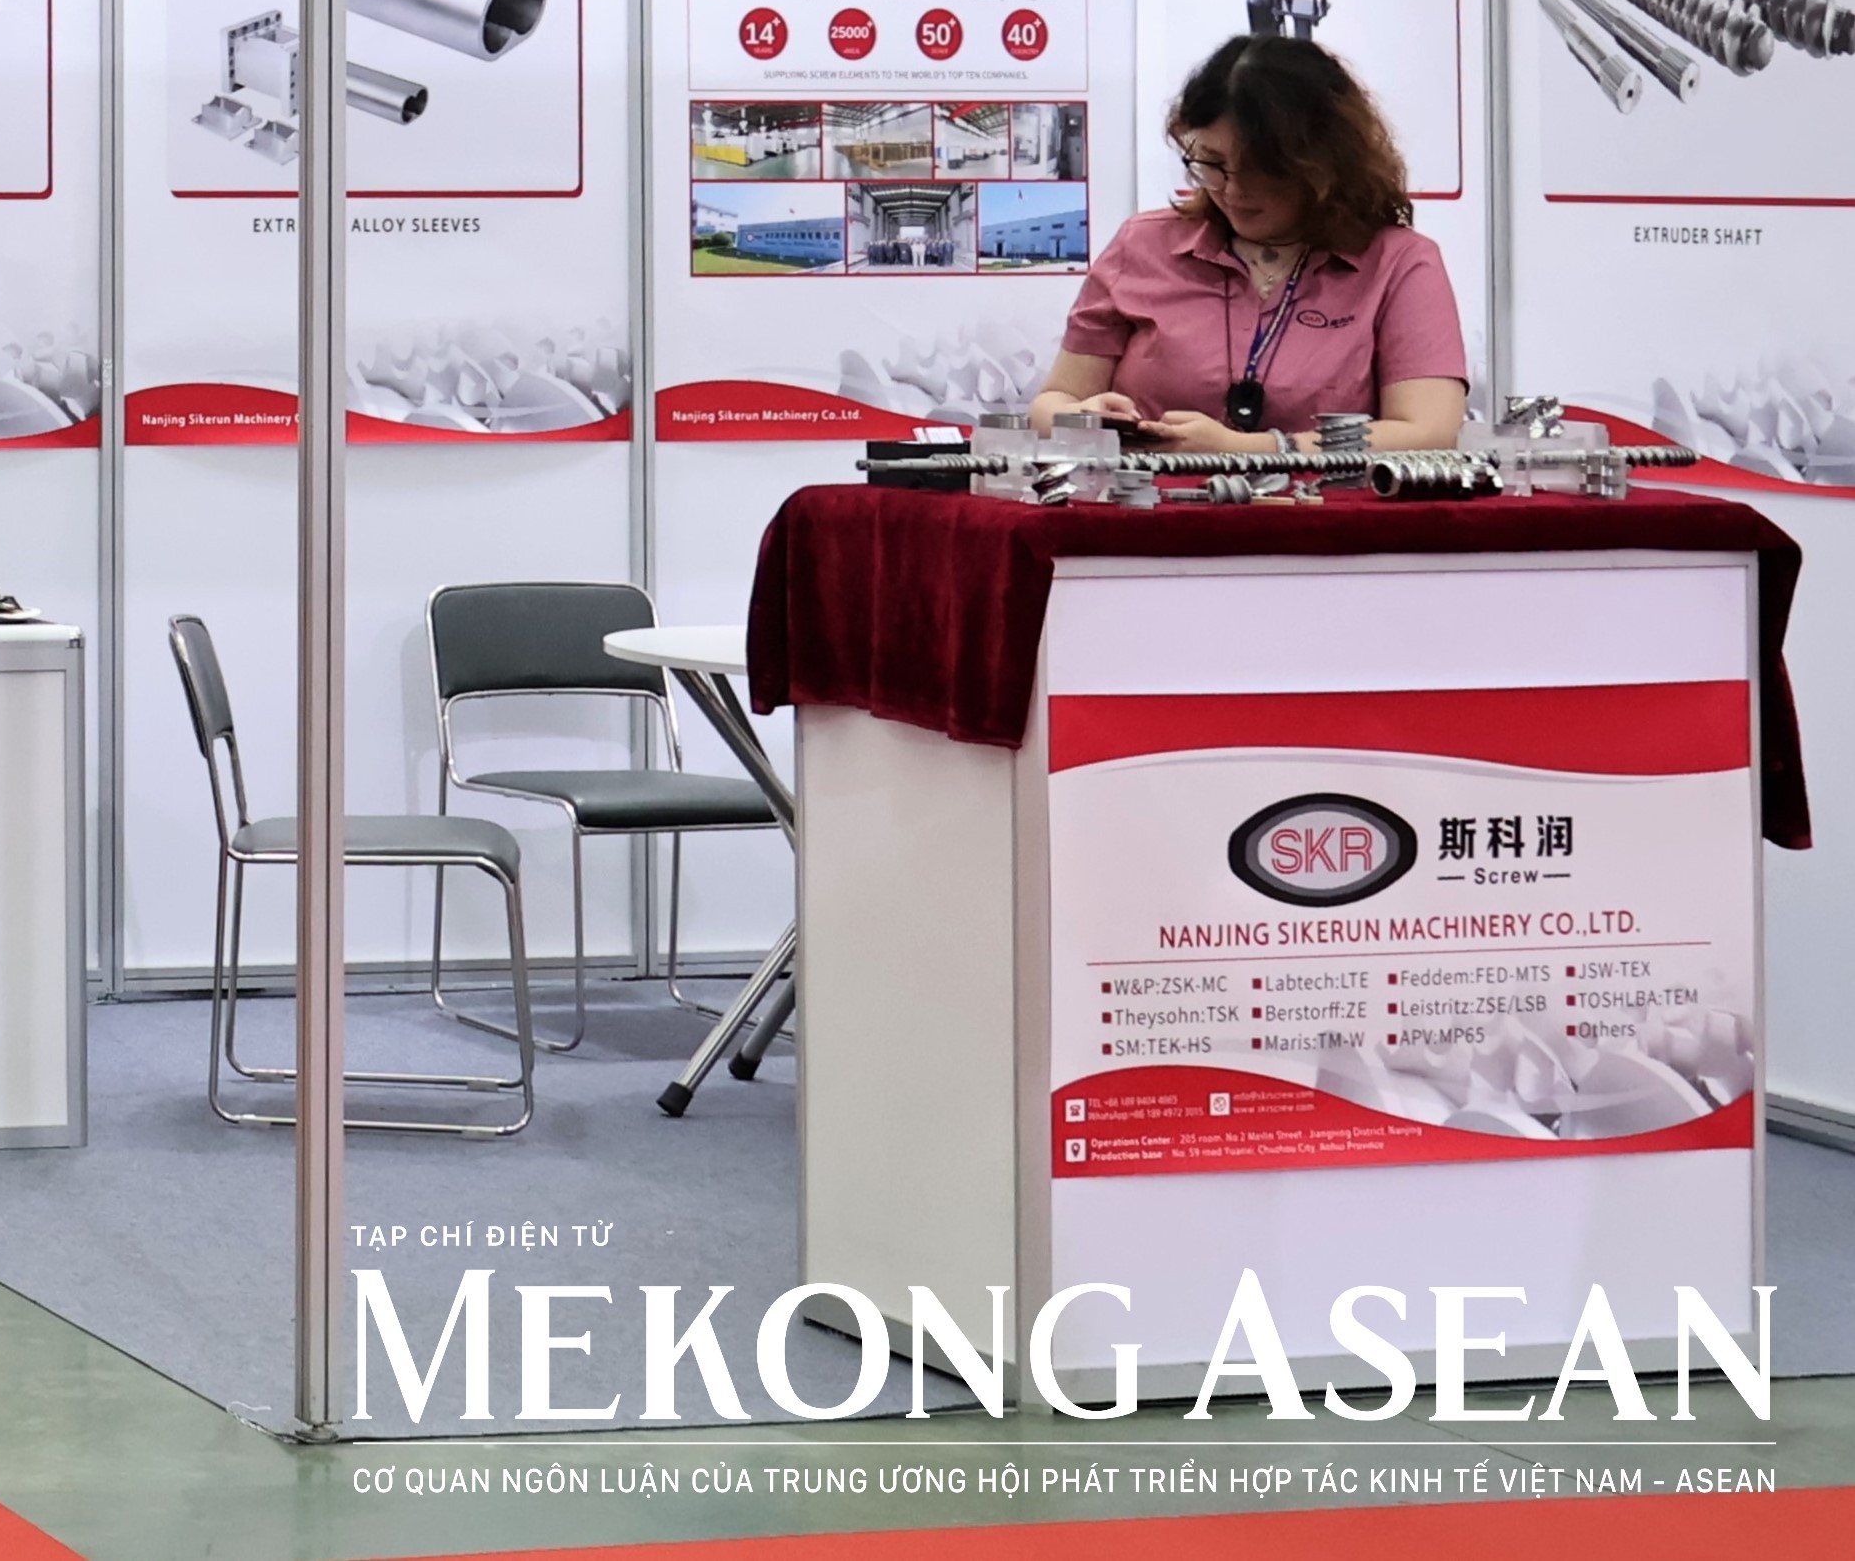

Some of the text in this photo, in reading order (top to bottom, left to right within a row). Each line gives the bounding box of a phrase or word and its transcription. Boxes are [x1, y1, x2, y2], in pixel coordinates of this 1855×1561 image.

[1439, 815, 1573, 860] 斯科润
[1271, 826, 1373, 874] SKR
[1474, 868, 1539, 885] Screw
[1159, 923, 1269, 948] NANJING
[1277, 919, 1380, 944] SIKERUN
[1390, 914, 1532, 941] MACHINERY
[1400, 965, 1550, 987] Feddem:FED-MTS
[1579, 961, 1650, 979] JSW-TEX
[1114, 976, 1228, 996] W&P:ZSK-MC
[1265, 971, 1369, 992] Labtech:LTE
[1265, 1002, 1367, 1022] Berstorff:ZE
[1400, 995, 1547, 1016] Leistritz:ZSE/LSB
[1115, 1005, 1239, 1029] Theysohn:TSK
[1400, 1027, 1485, 1046] APV:MP65
[1579, 1020, 1635, 1038] Others
[1115, 1037, 1212, 1056] SM:TEK-HS
[1265, 1032, 1365, 1051] Maris:TM-W
